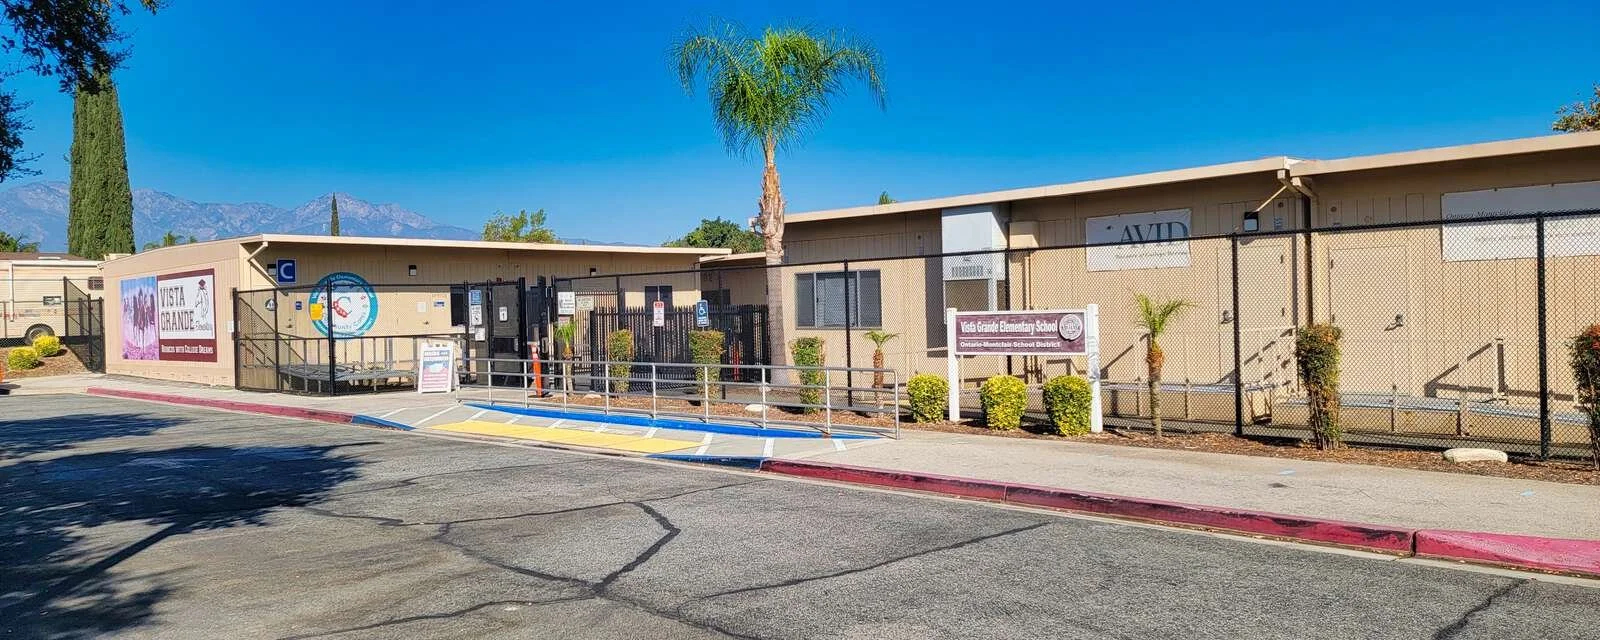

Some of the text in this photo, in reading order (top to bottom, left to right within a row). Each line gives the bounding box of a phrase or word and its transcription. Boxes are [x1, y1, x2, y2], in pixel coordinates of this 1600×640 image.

[1117, 221, 1188, 249] AVID
[280, 263, 293, 279] C
[160, 286, 185, 307] VISTA
[160, 311, 194, 331] GRANDE
[960, 320, 1057, 335] Vista Grande Elementary School
